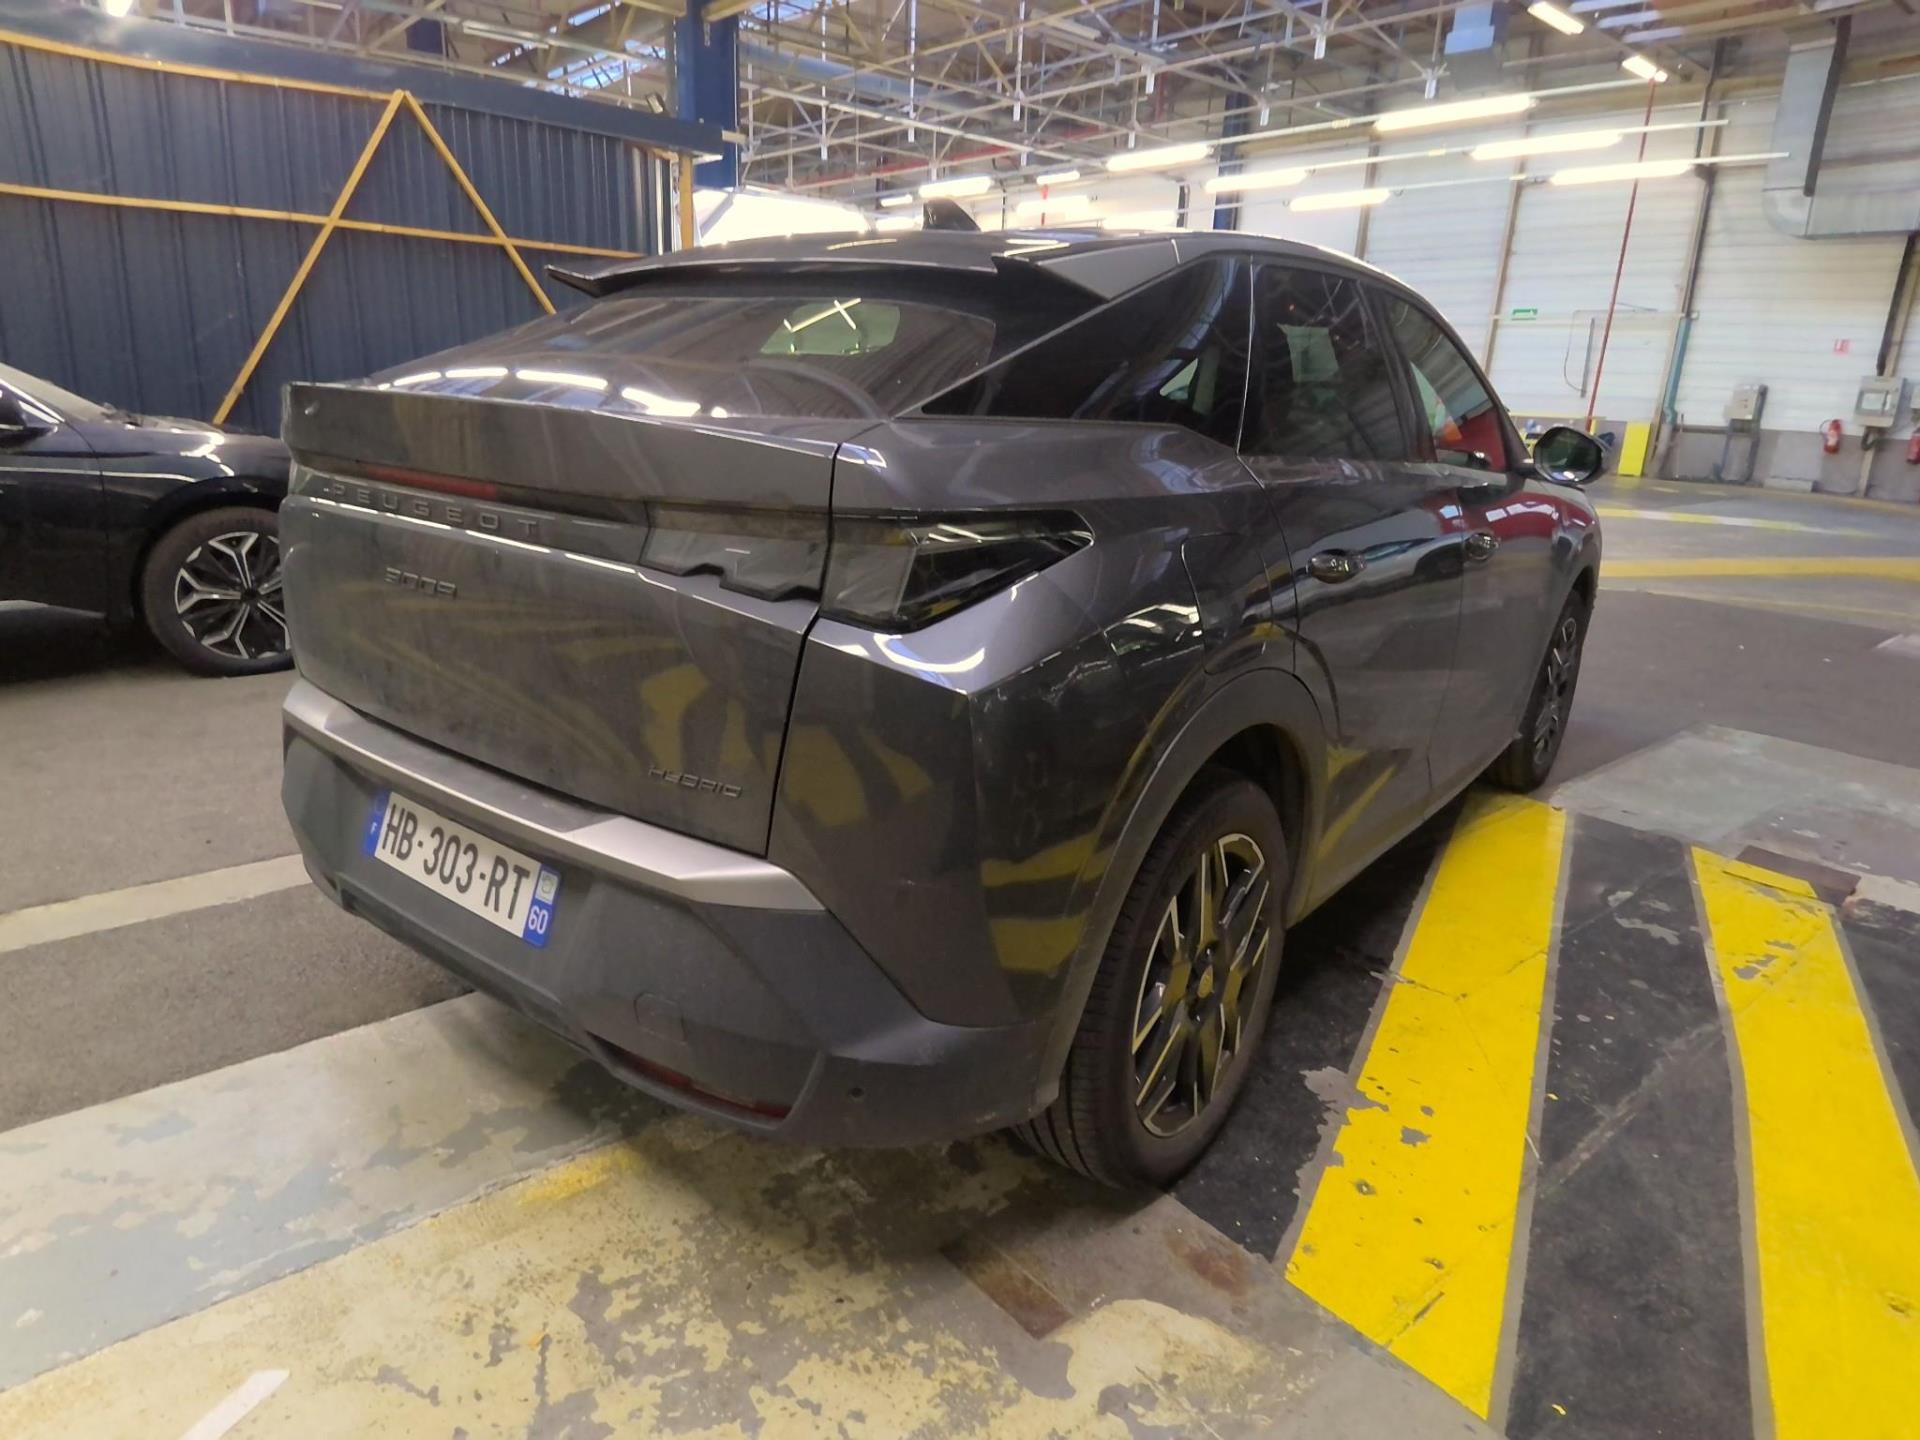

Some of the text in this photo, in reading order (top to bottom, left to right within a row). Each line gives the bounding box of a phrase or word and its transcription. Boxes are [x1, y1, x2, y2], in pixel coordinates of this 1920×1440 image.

[331, 484, 538, 536] PEUGEOT
[381, 803, 531, 920] HB-303-RT
[528, 905, 549, 935] 60
